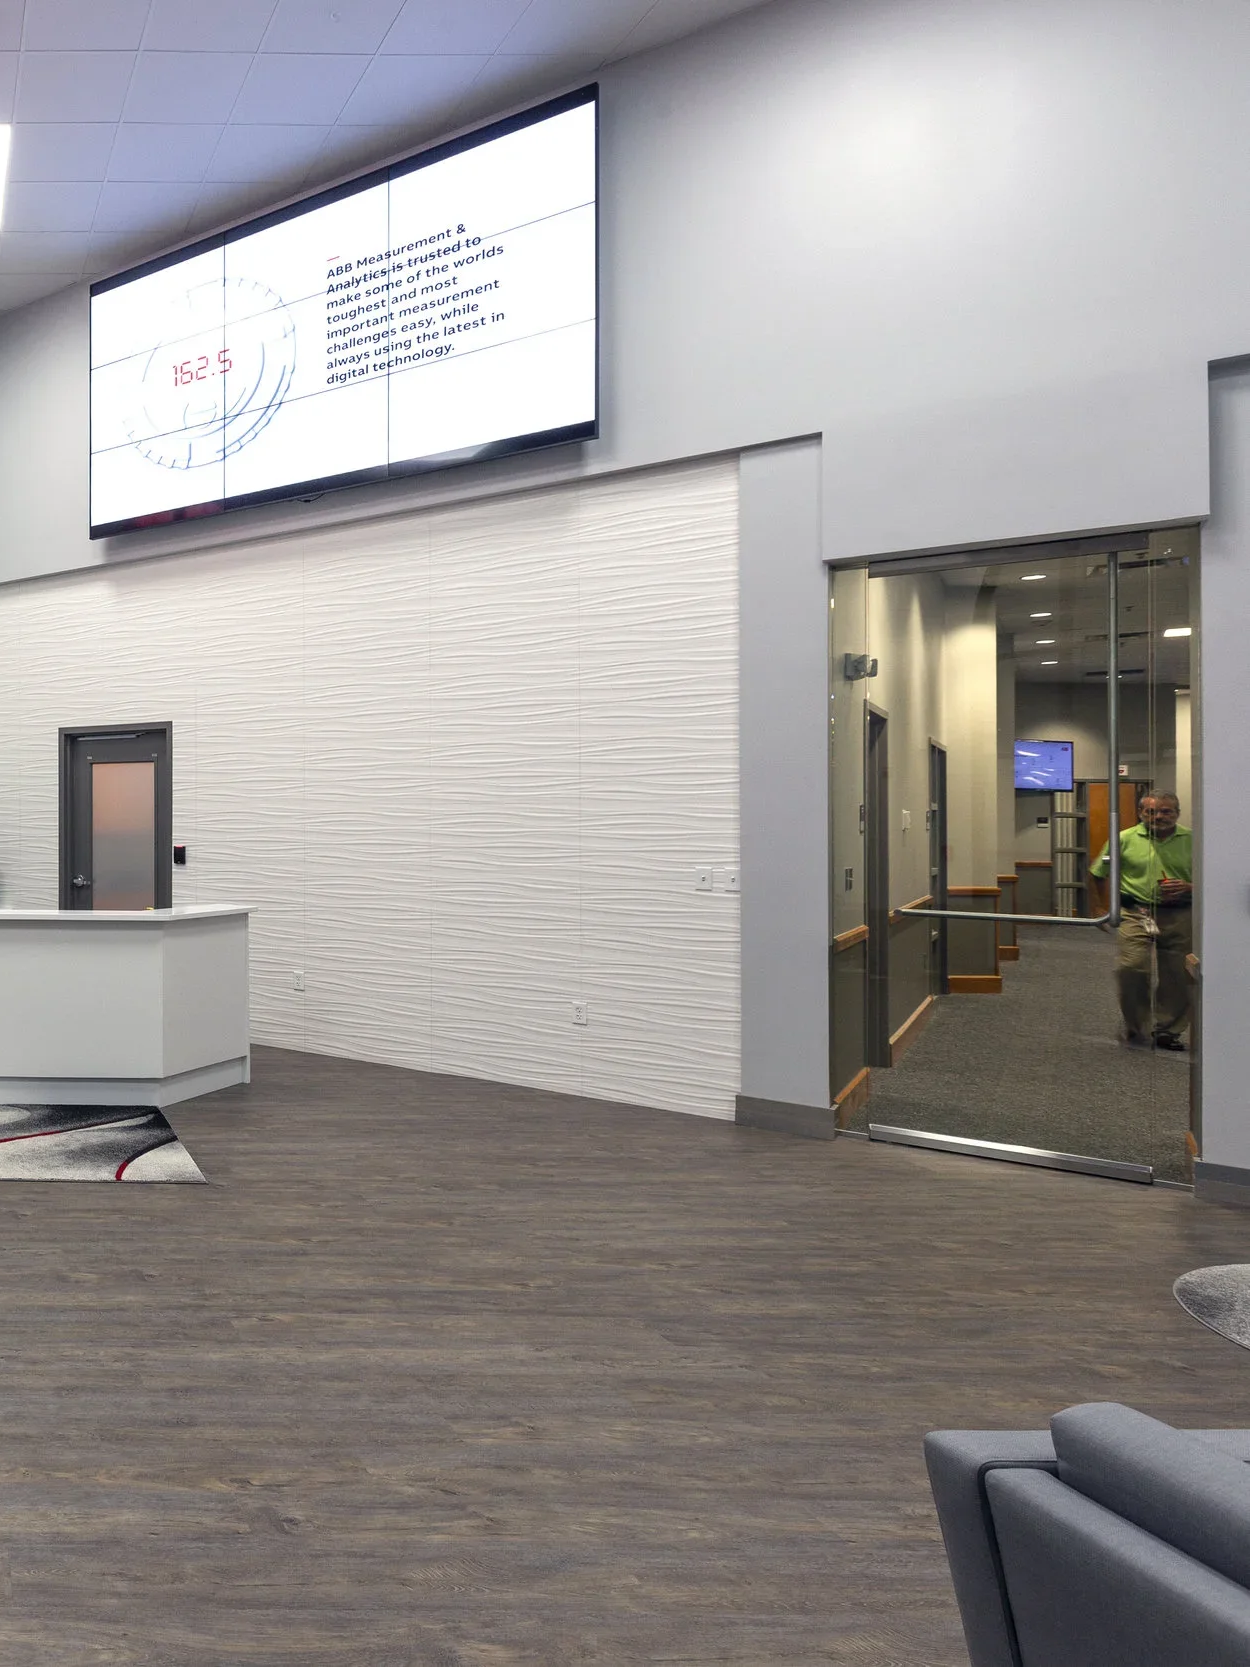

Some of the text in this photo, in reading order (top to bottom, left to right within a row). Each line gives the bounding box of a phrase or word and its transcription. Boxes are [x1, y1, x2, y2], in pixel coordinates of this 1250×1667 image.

[326, 223, 466, 279] ABB Measurement &
[326, 236, 482, 295] Analytics is trusted to
[326, 245, 504, 310] make some of the worlds
[326, 276, 458, 324] toughest and most
[326, 279, 500, 340] important measurement
[326, 302, 479, 354] challenges easy, while
[173, 349, 232, 386] 162.5
[326, 311, 505, 370] always using the latest in
[326, 343, 455, 385] digital technology.
